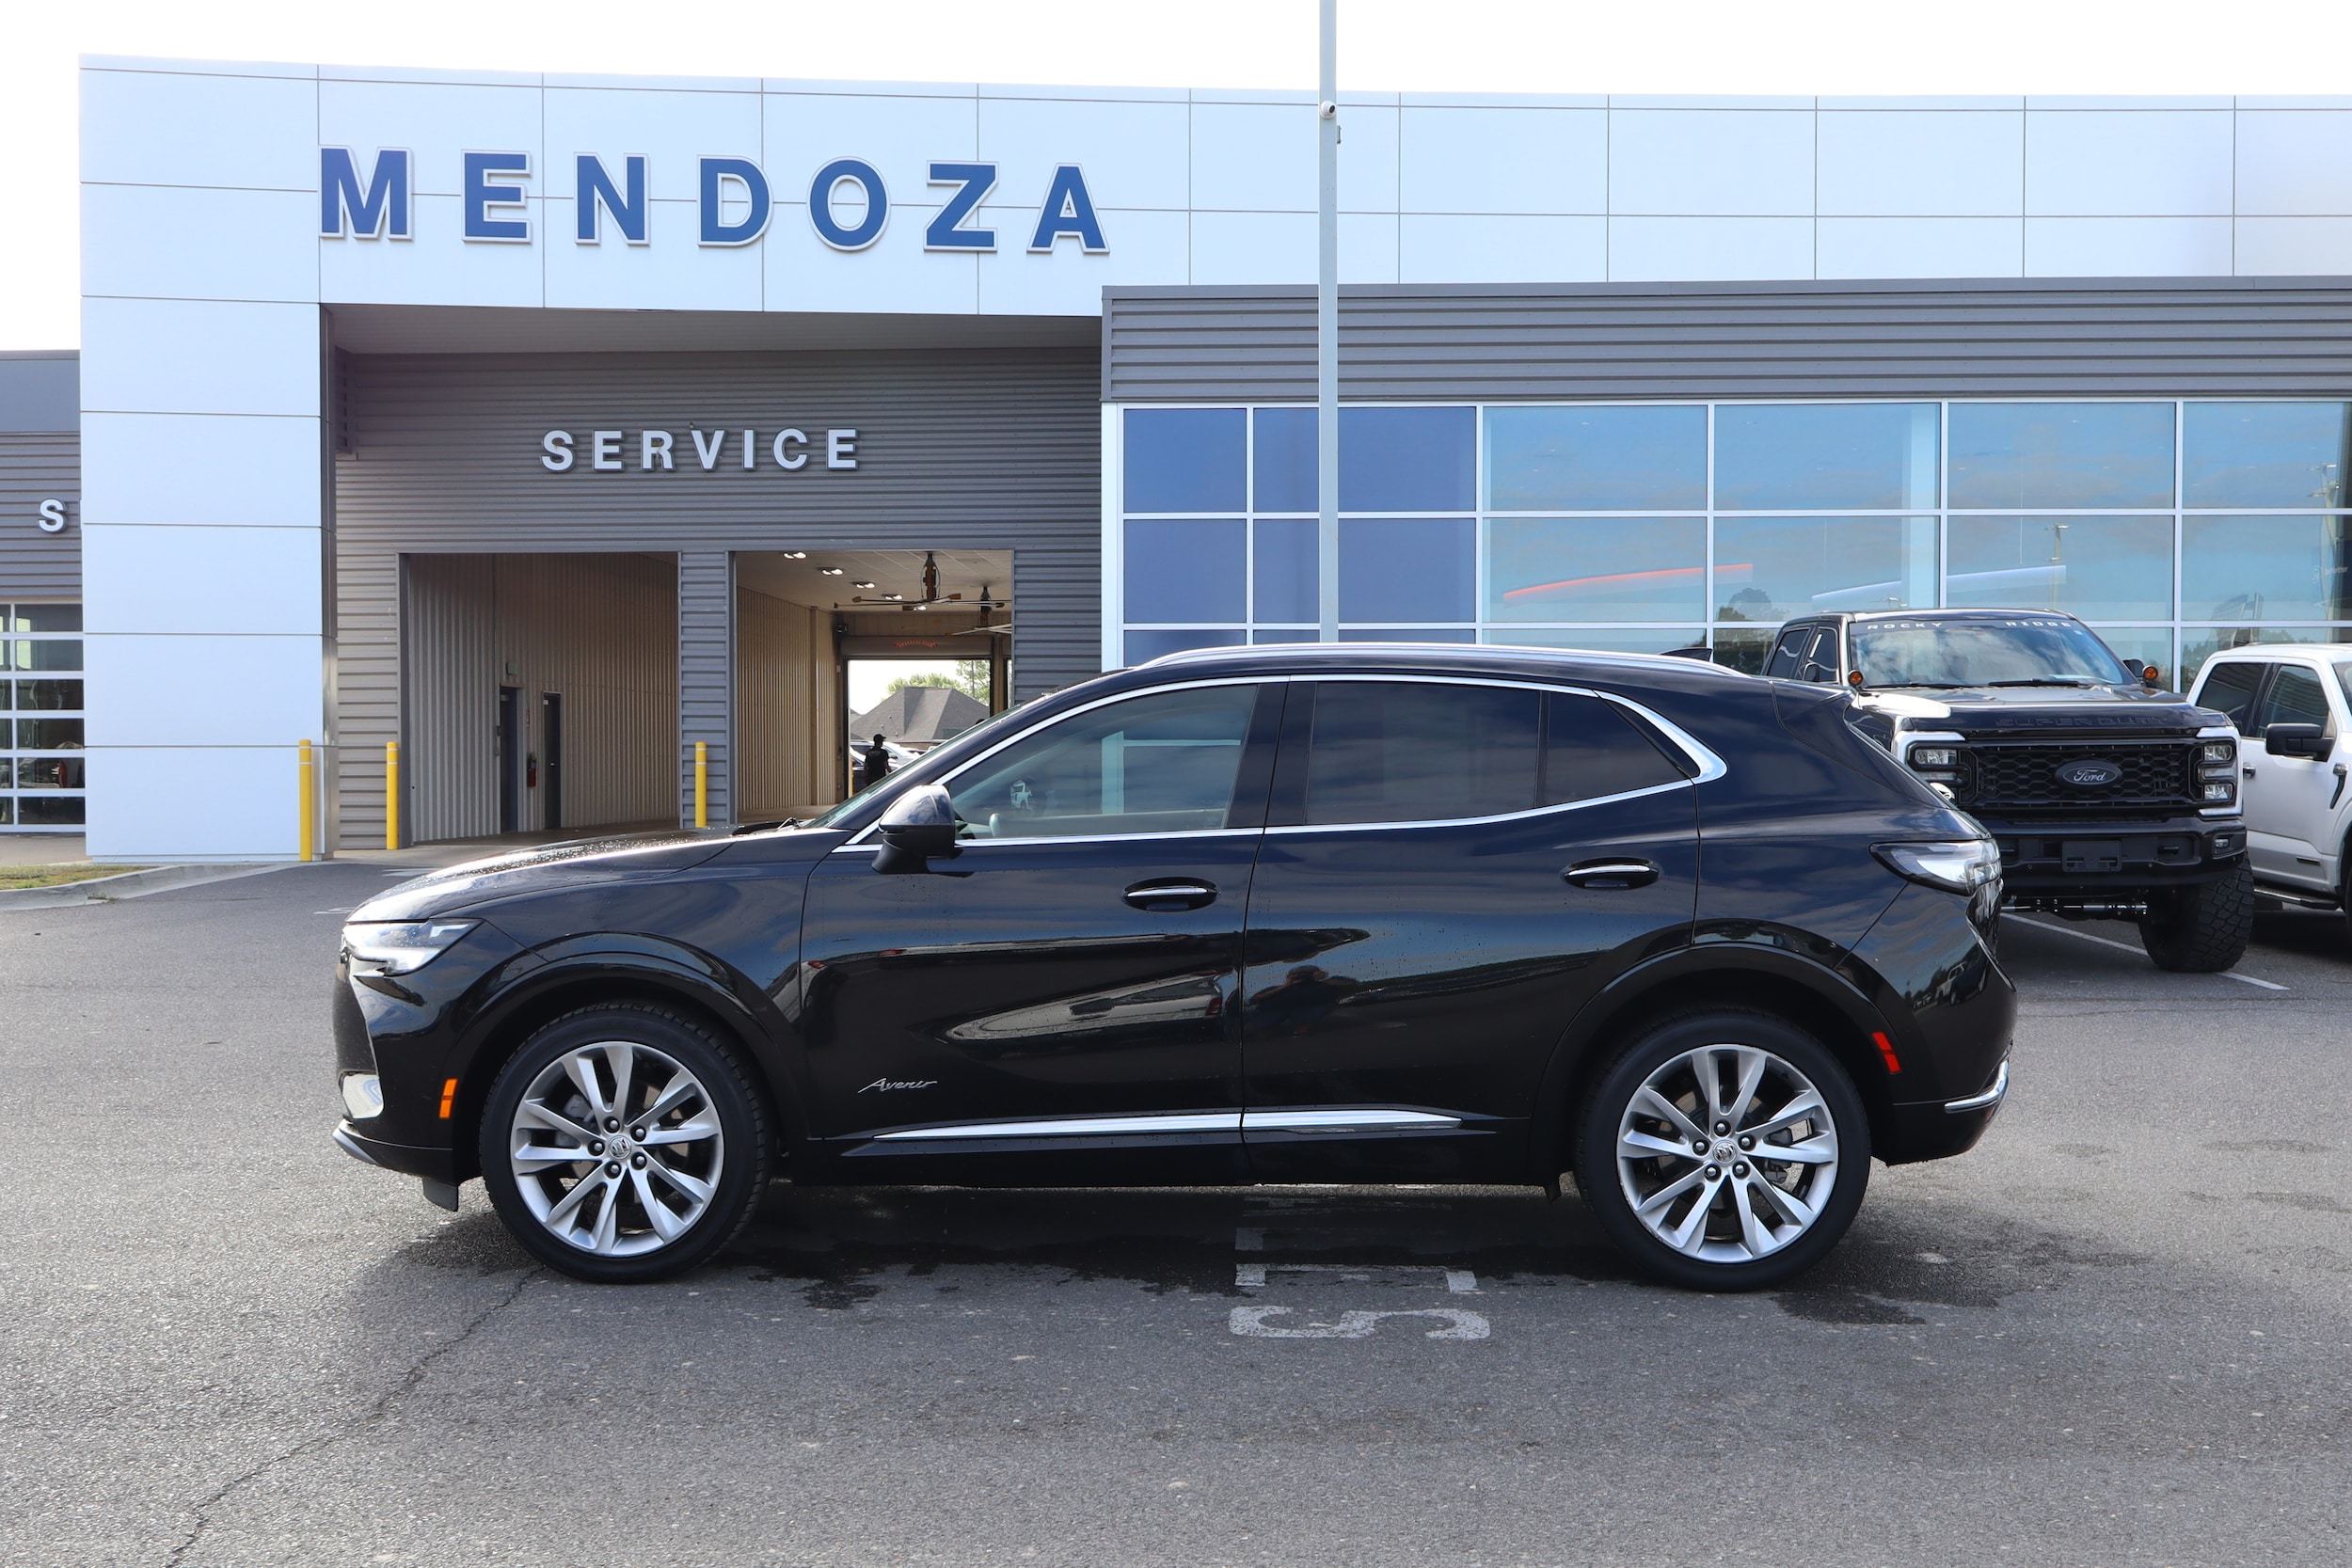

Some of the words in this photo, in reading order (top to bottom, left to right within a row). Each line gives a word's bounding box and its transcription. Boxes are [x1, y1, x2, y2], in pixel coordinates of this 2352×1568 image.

[320, 145, 1109, 254] MENDOZA
[540, 428, 859, 473] SERVICE
[1867, 622, 1943, 630] ROCKY
[2005, 620, 2073, 628] RIDGE
[1995, 718, 2093, 727] SUPER
[2099, 716, 2170, 726] DUTY
[2073, 769, 2107, 782] Ford
[857, 1077, 938, 1094] Avenir
